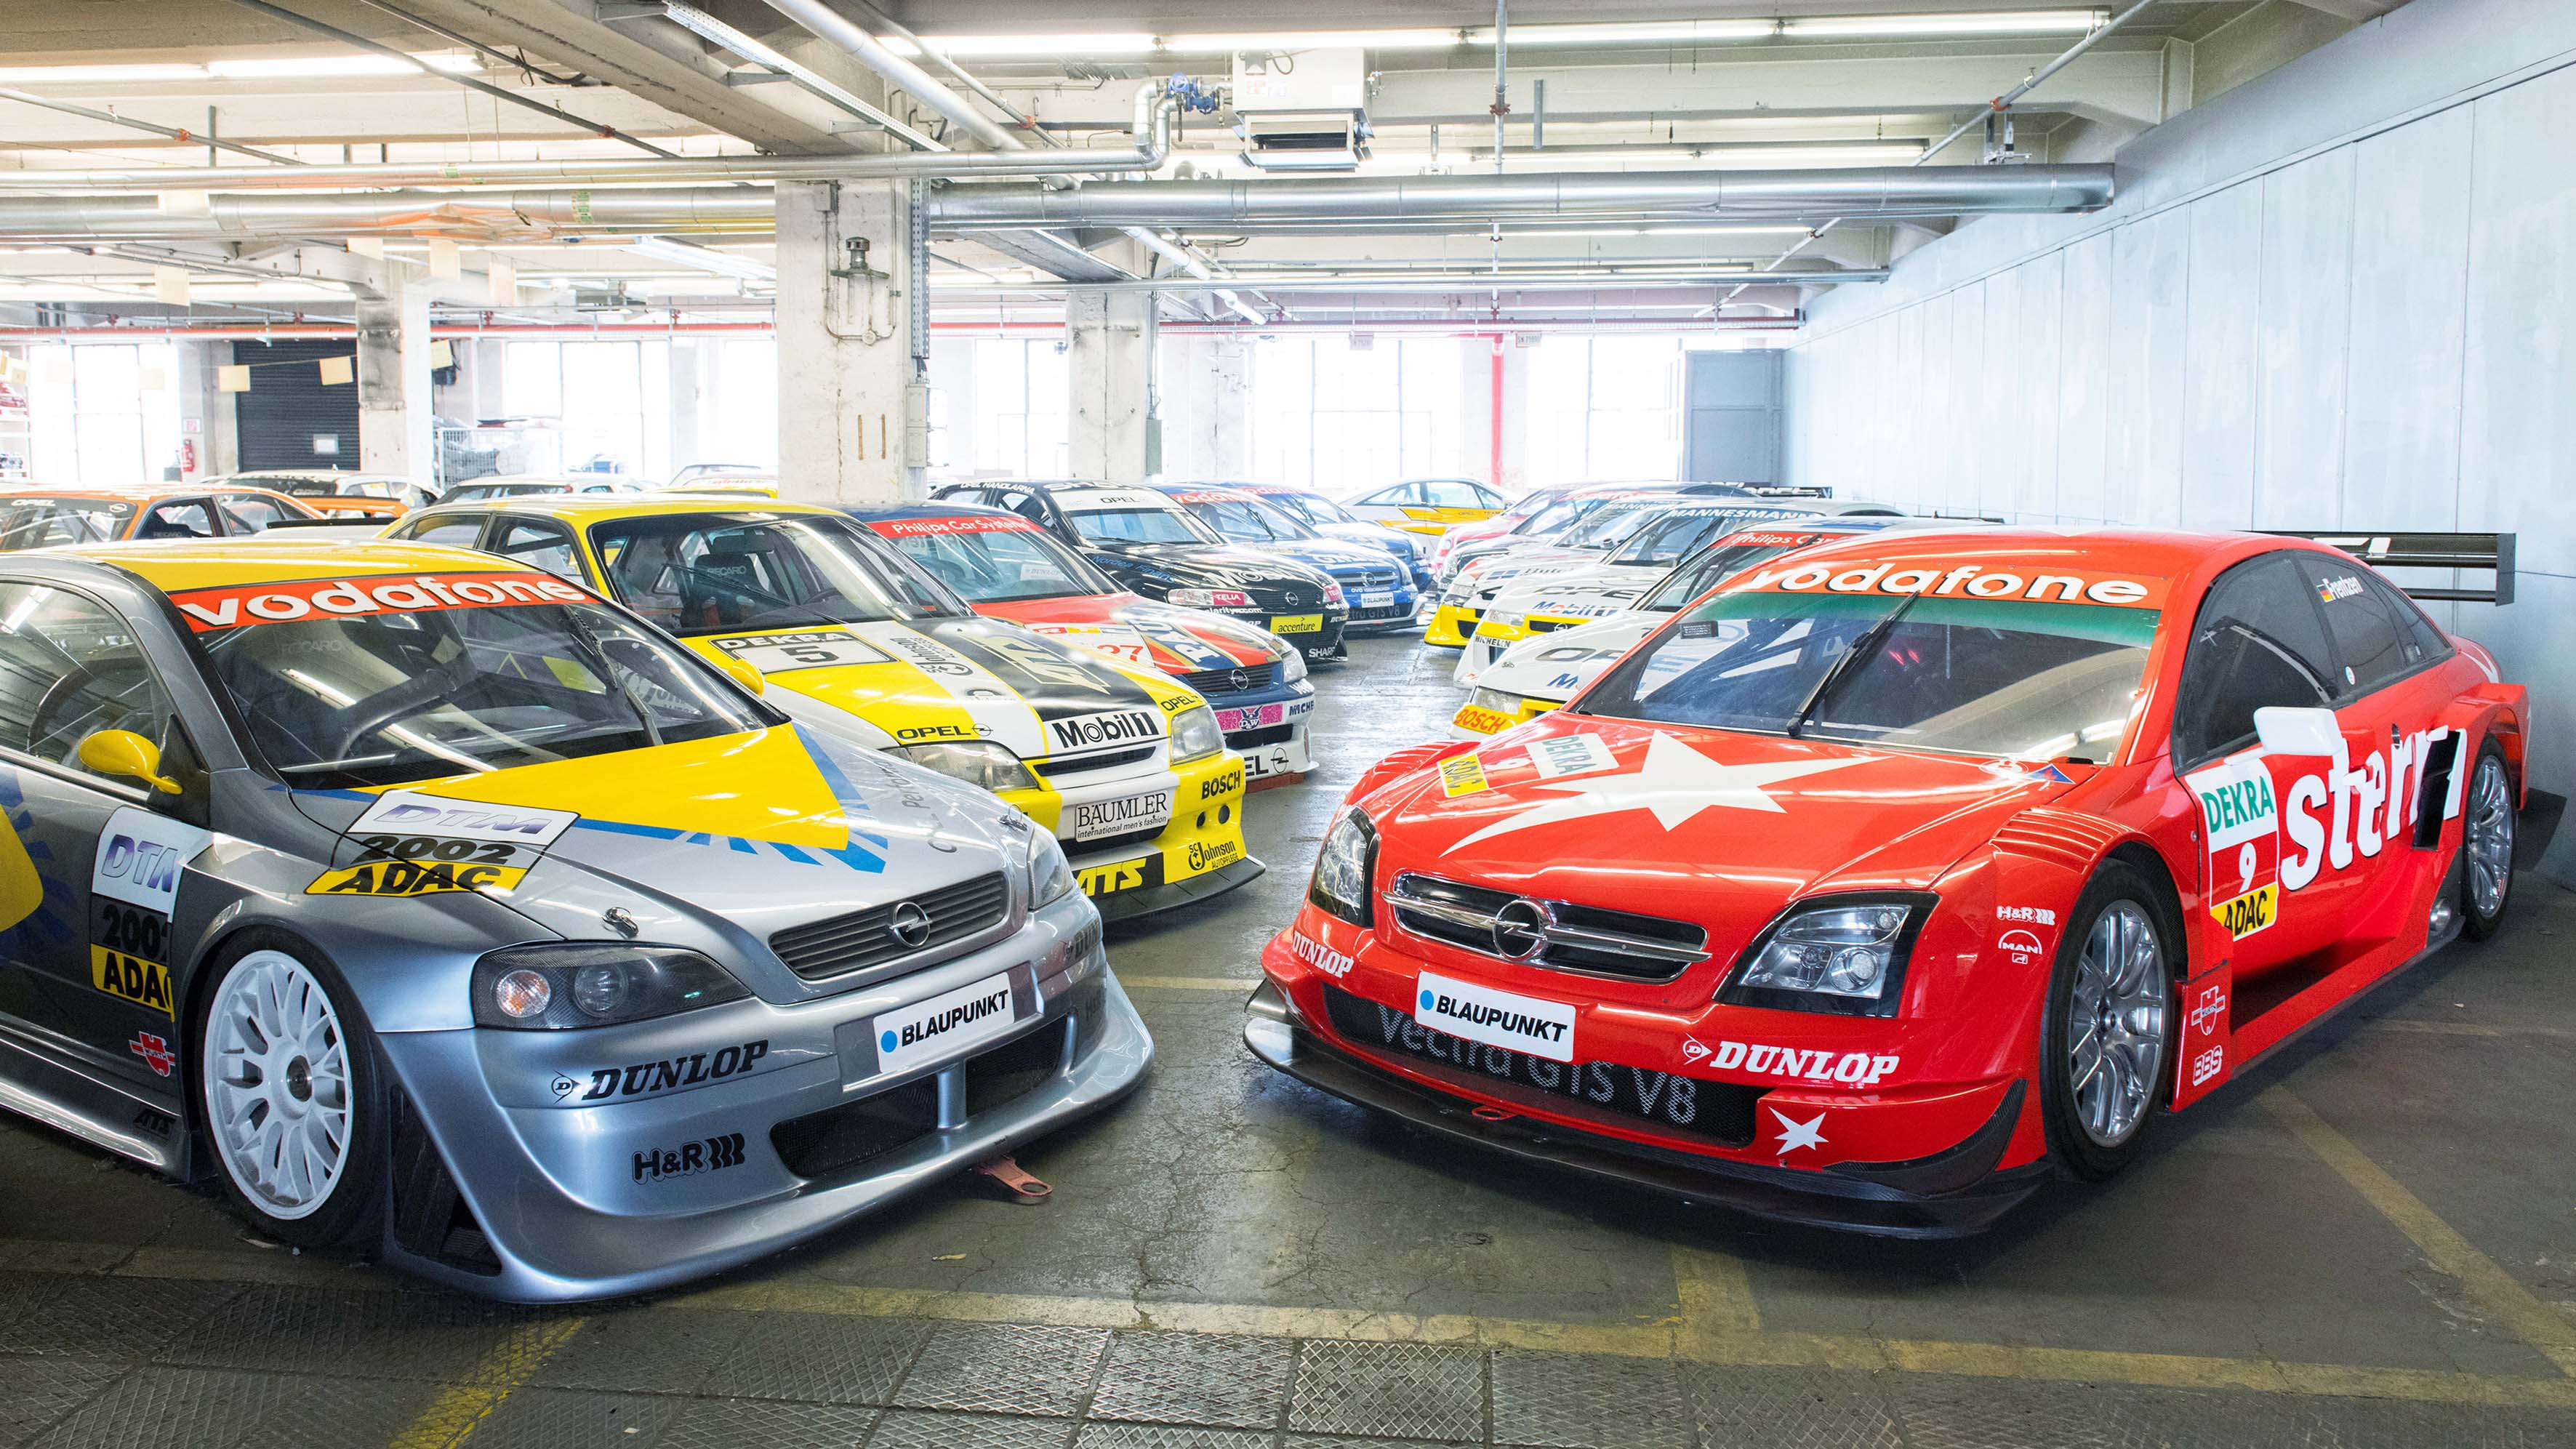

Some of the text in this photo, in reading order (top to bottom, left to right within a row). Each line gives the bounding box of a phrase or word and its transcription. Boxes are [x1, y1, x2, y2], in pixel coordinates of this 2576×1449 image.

[1099, 496, 1140, 505] OPEL
[891, 519, 1031, 534] Philips Car Systems
[1733, 533, 1793, 545] Philips
[707, 565, 747, 577] RECARO
[1091, 554, 1175, 583] Nordea Finans
[1752, 563, 2147, 606] vodafone
[2322, 575, 2364, 601] Frentzen
[179, 577, 585, 627] vodafone
[1387, 605, 1401, 617] V8
[714, 631, 856, 650] DEKRA
[1277, 622, 1316, 633] accenture
[1474, 635, 1511, 648] MICHELIN
[784, 646, 839, 664] 5
[1160, 695, 1192, 712] OPEL
[1288, 700, 1315, 716] MICHE
[896, 725, 971, 740] OPEL
[1051, 713, 1136, 749] Mobil
[1240, 718, 1259, 729] D&W
[1455, 707, 1509, 734] BOSCH
[1245, 754, 1269, 778] EL
[1541, 736, 1598, 776] DEKRA
[1201, 769, 1242, 800] BOSCH
[373, 803, 553, 835] DTM
[1077, 792, 1168, 827] BÄUMLER
[2200, 774, 2275, 834] DEKRA
[2281, 725, 2468, 891] stern
[1077, 813, 1168, 839] international men's fashion
[349, 835, 517, 866] 2002
[1188, 840, 1237, 872] SC Johnson
[1211, 854, 1240, 871] AUTOPFLEGE
[326, 862, 502, 894] ADAC
[1075, 857, 1147, 897] ATS
[2238, 841, 2258, 894] 9
[1996, 905, 2037, 923] H&R
[2223, 888, 2268, 933] ADAC
[1291, 929, 1355, 979] DUNLOP
[2002, 942, 2039, 955] MAN
[901, 987, 1009, 1048] BLAUPUNKT
[1435, 994, 1569, 1043] BLAUPUNKT
[581, 1039, 769, 1101] DUNLOP
[1709, 1040, 1900, 1085] DUNLOP
[2192, 1044, 2223, 1087] BBS
[1632, 1066, 1697, 1125] V8
[631, 1139, 710, 1186] H&R
